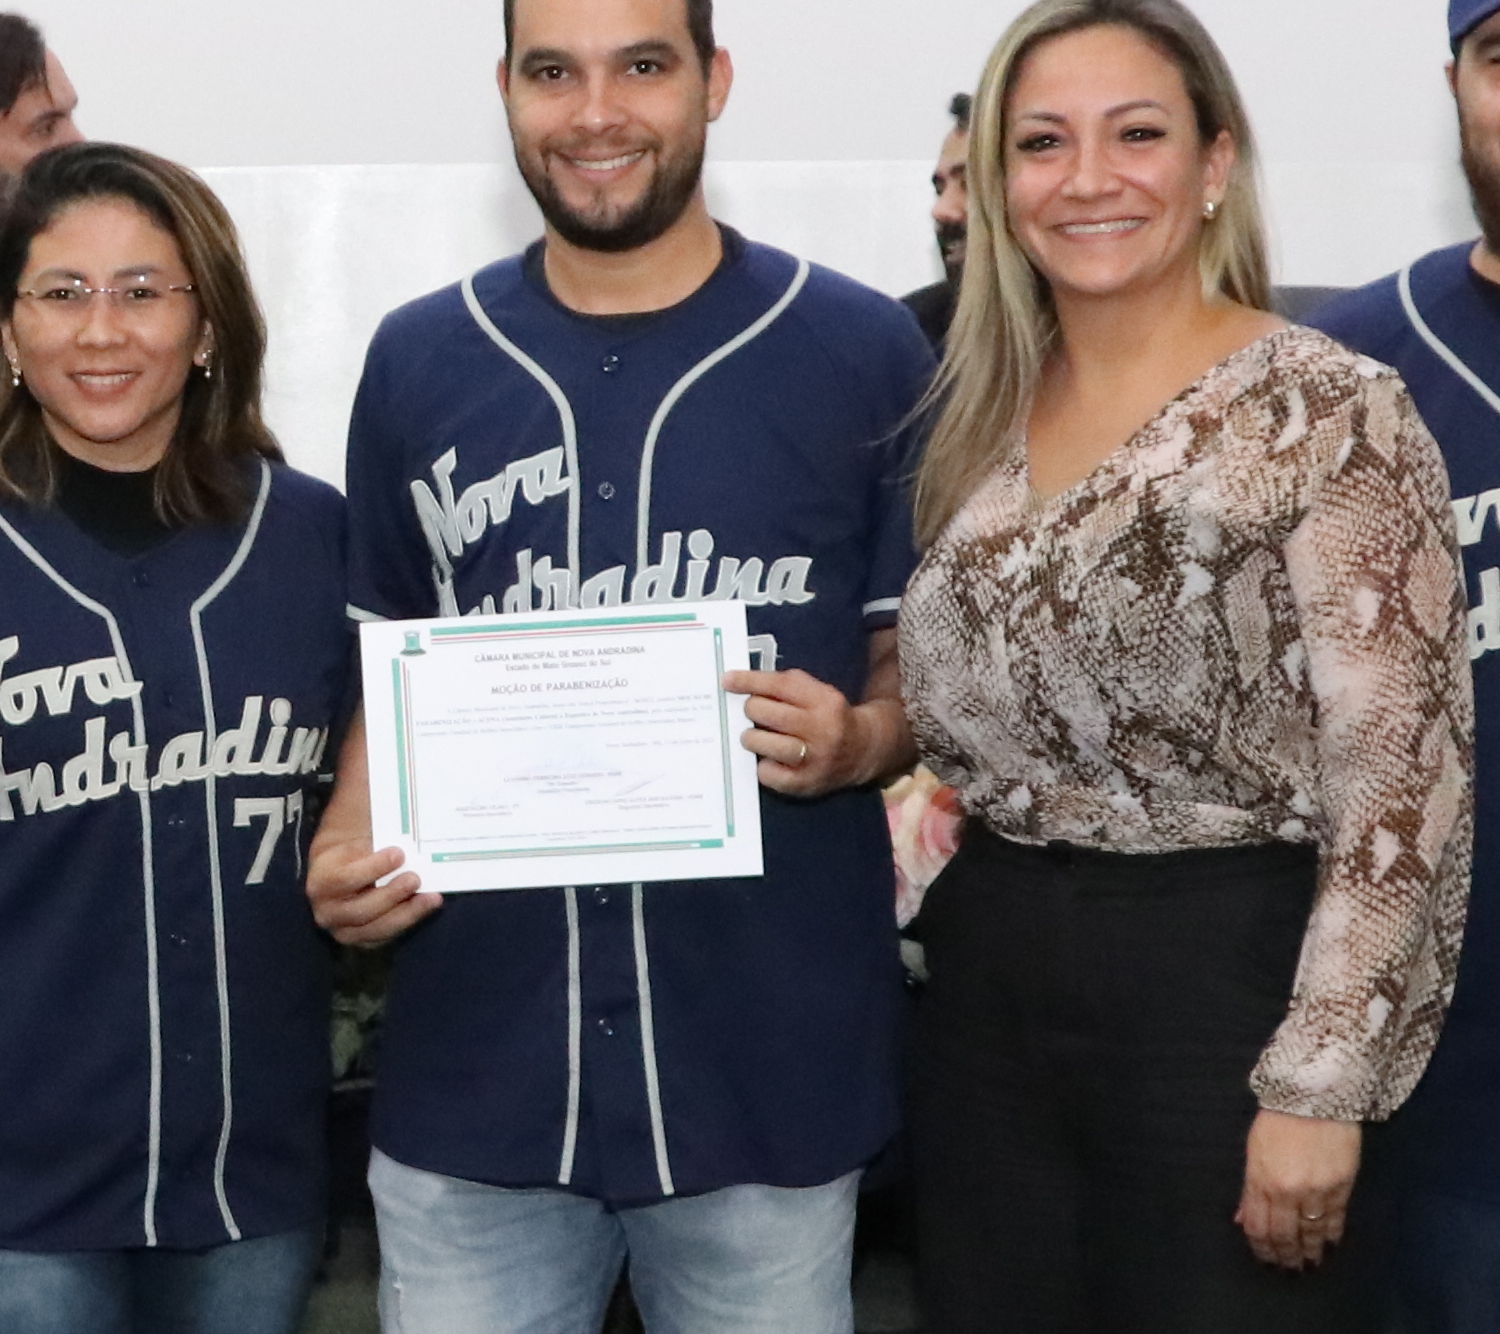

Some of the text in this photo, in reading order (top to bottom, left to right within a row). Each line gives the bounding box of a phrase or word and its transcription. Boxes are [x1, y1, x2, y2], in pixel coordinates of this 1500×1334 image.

[559, 650, 570, 658] DE
[491, 677, 629, 696] MOÇÃO DE PARABENIZAÇÃO
